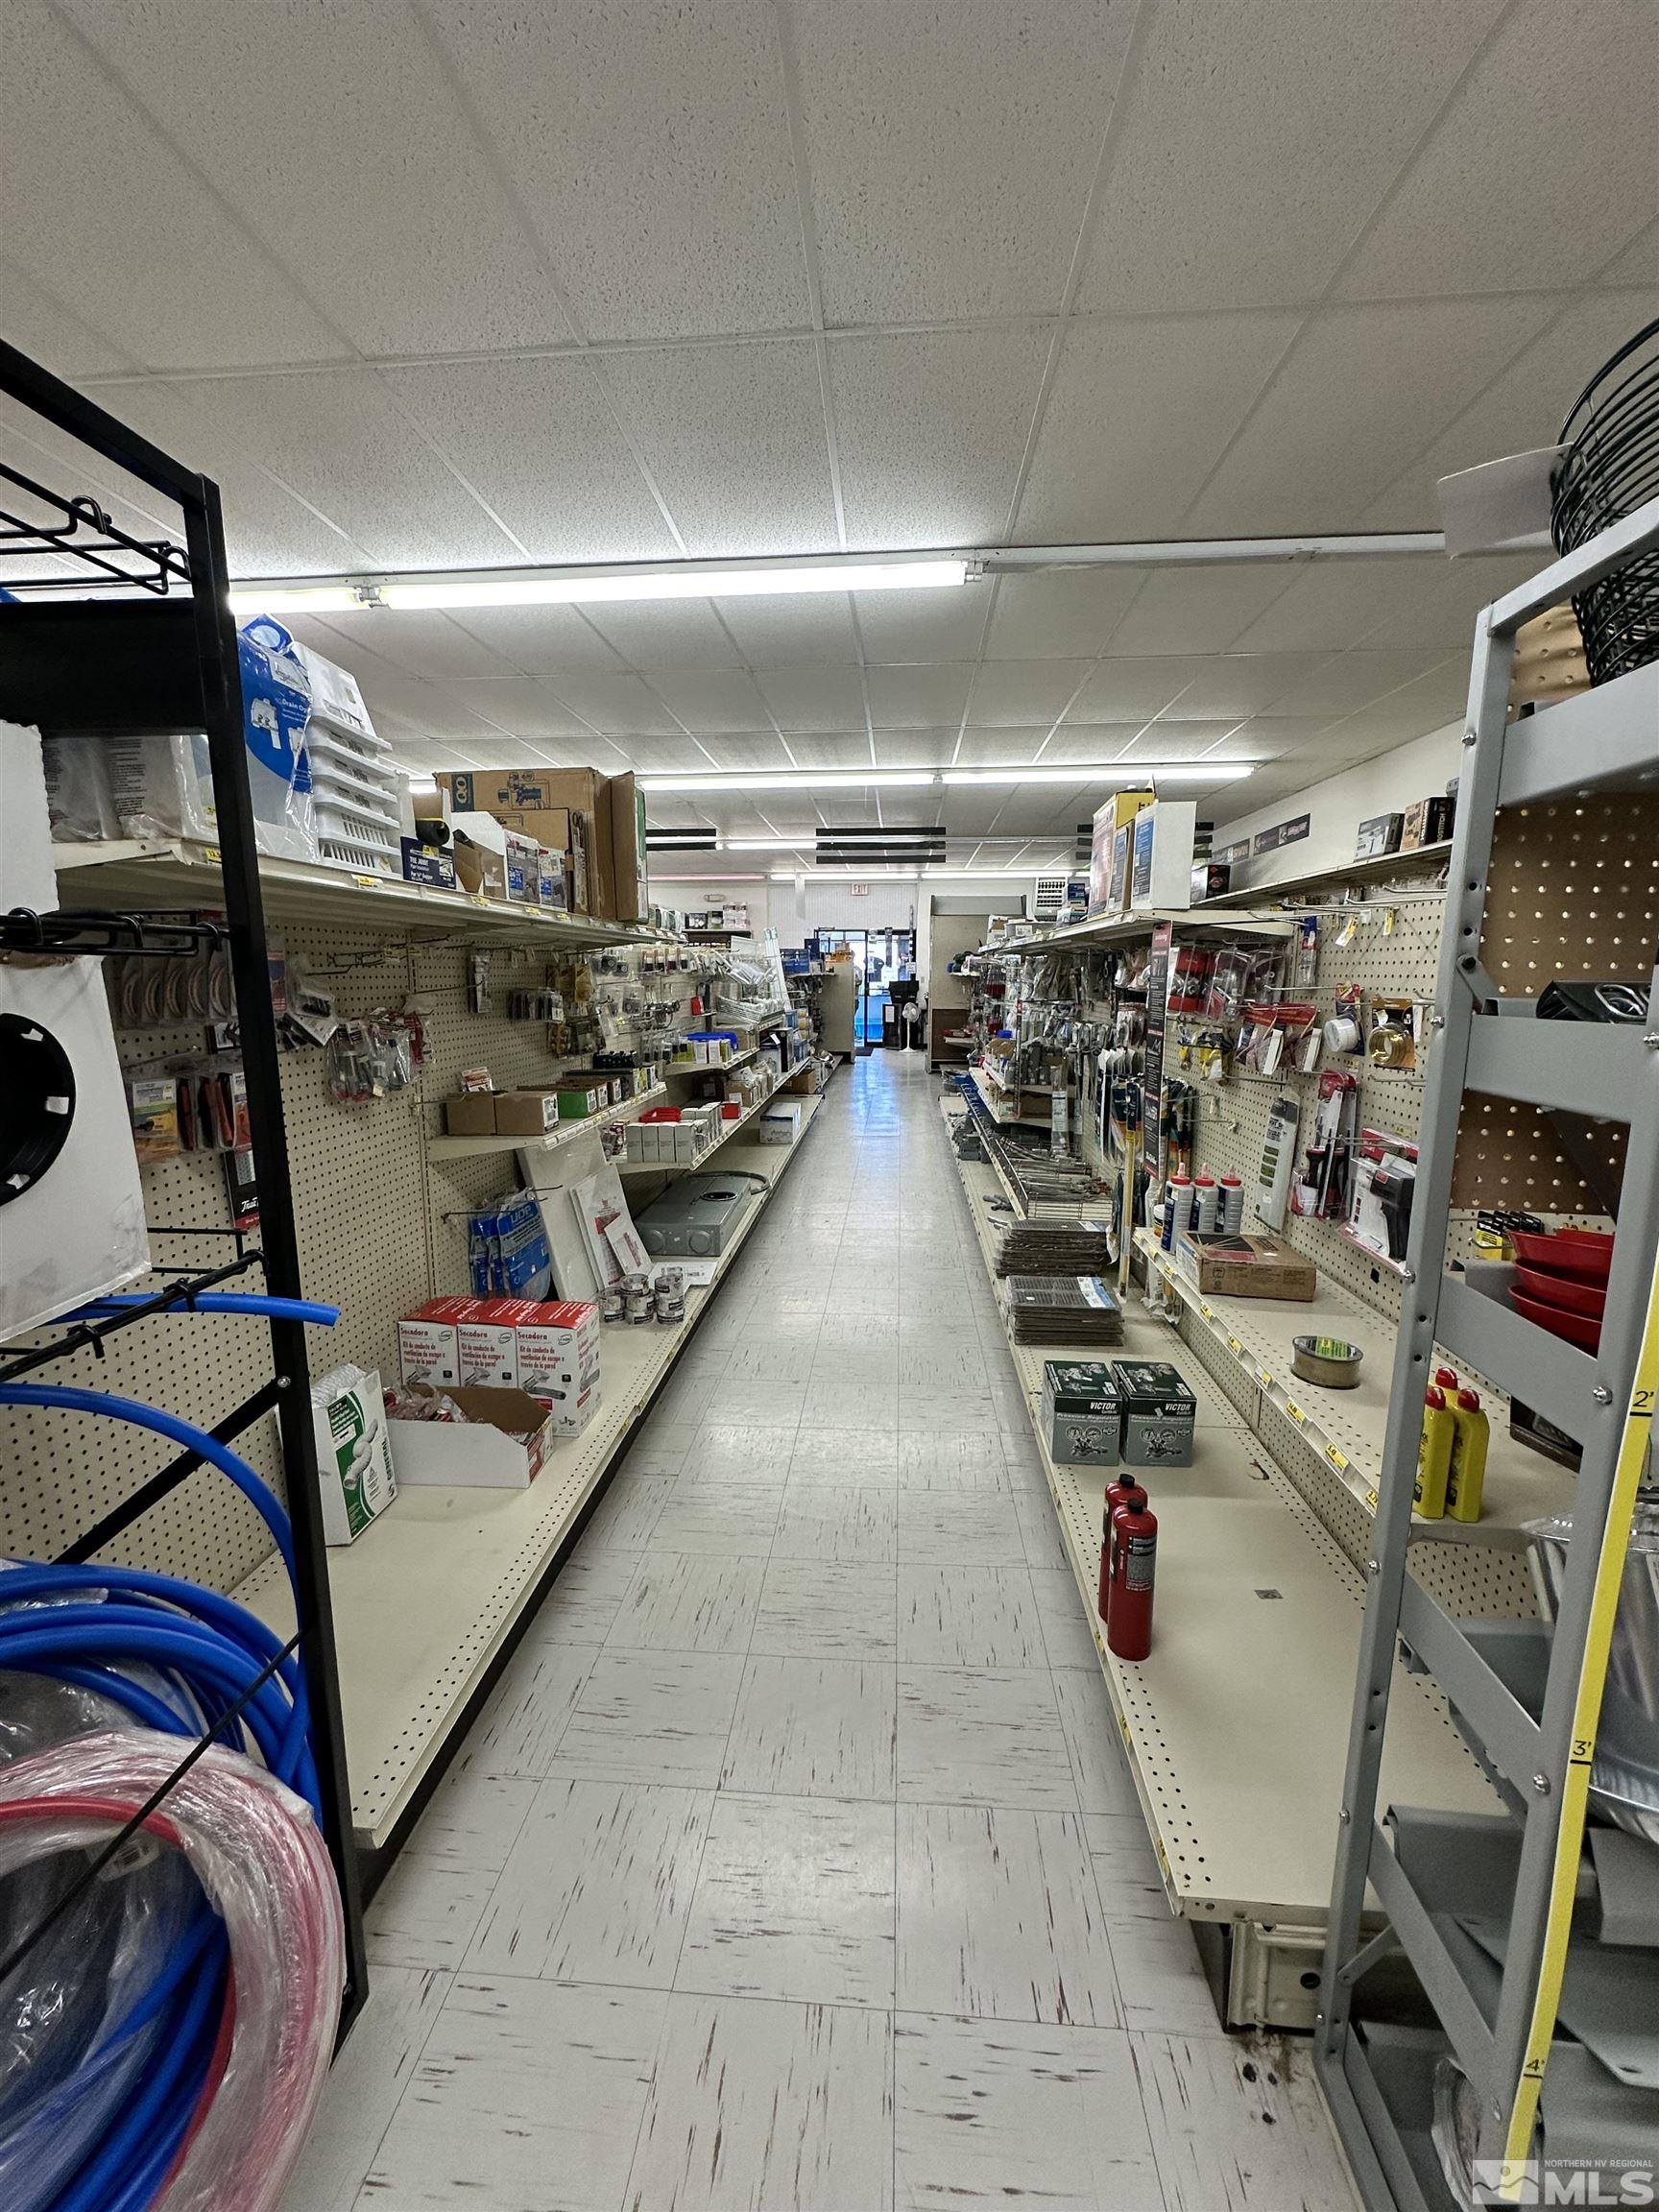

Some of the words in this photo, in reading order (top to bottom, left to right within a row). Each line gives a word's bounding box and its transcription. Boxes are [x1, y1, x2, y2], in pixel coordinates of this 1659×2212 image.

[281, 699, 299, 709] Drain
[400, 1327, 429, 1336] Secadora
[459, 1329, 488, 1338] Secadora
[517, 1332, 547, 1340] Secadora
[1090, 1401, 1117, 1410] VICTOR
[1165, 1403, 1191, 1411] VICTOR
